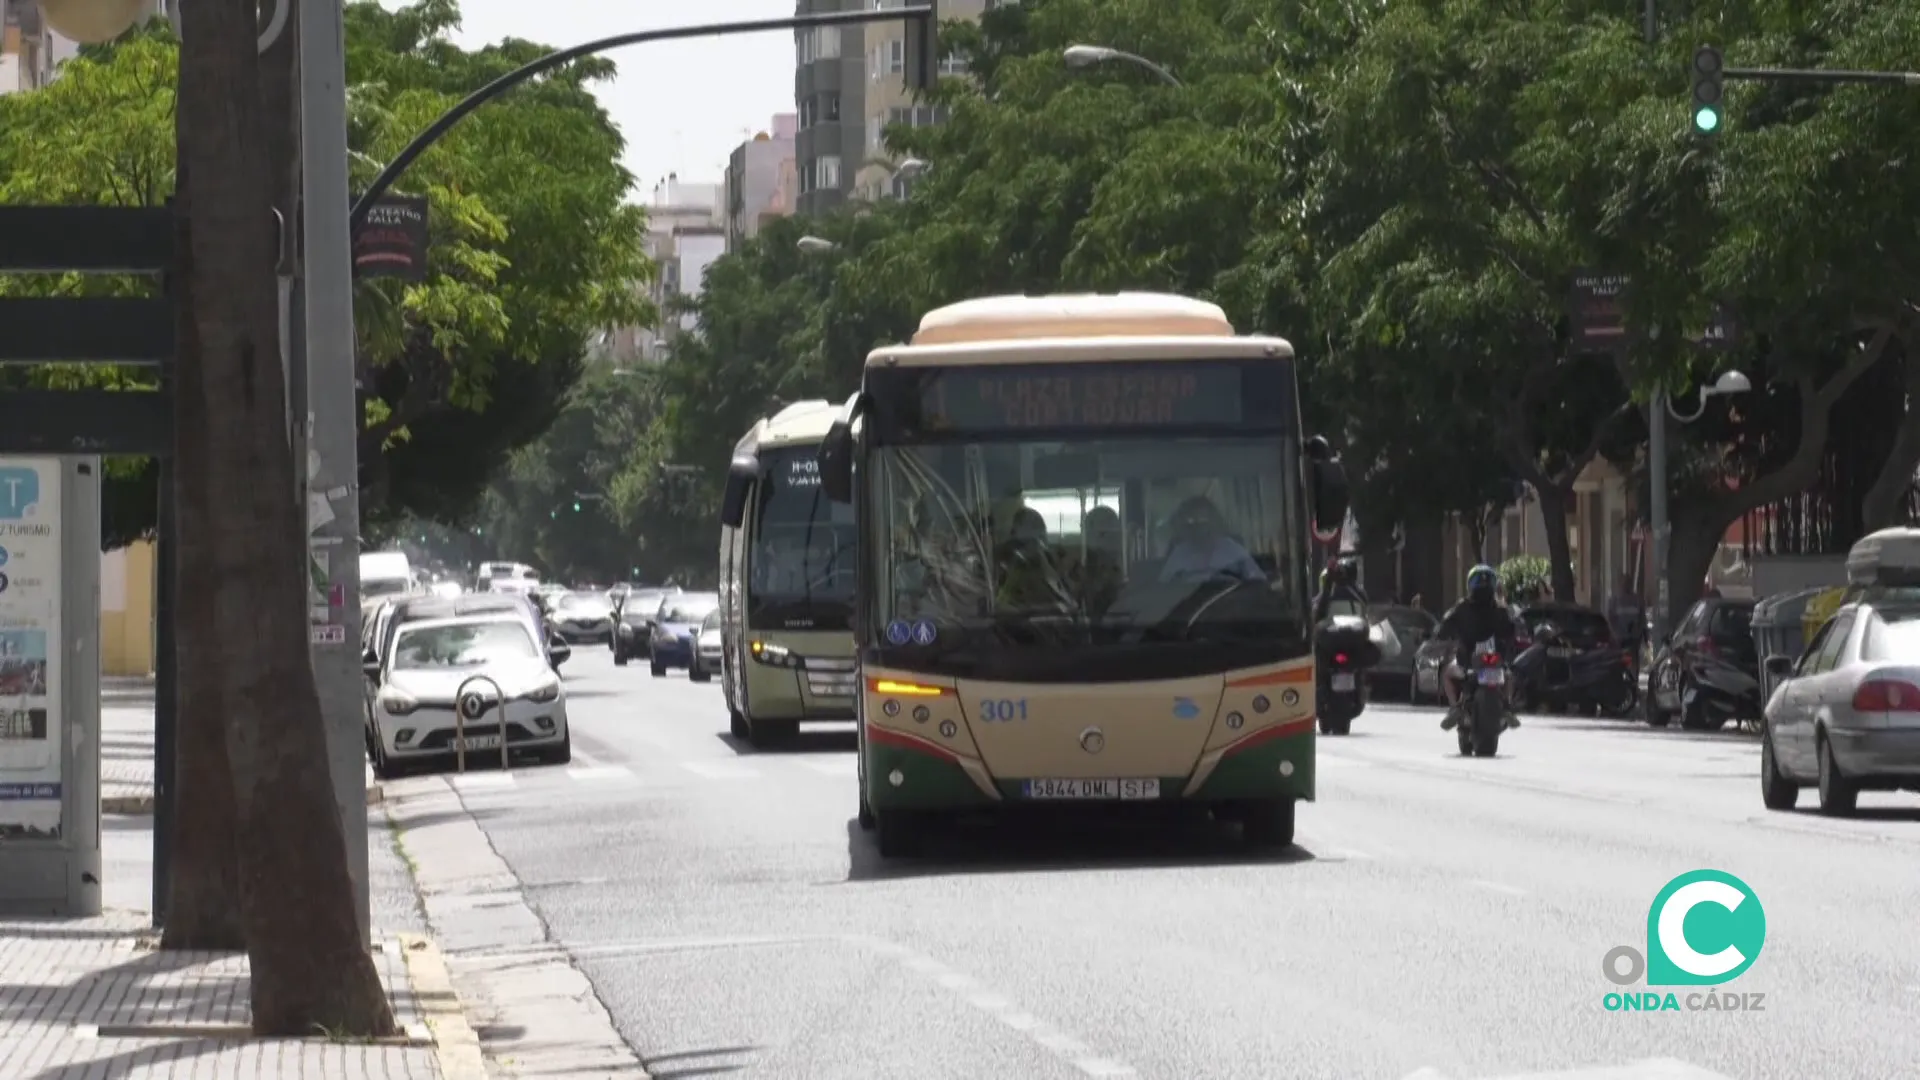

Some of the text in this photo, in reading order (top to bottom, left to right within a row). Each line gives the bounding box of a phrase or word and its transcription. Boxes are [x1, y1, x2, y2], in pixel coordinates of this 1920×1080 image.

[978, 376, 1072, 400] PLAZA
[8, 523, 51, 537] TURISMO
[979, 697, 1027, 722] 301
[1033, 780, 1077, 798] 5844
[1082, 781, 1112, 797] DML
